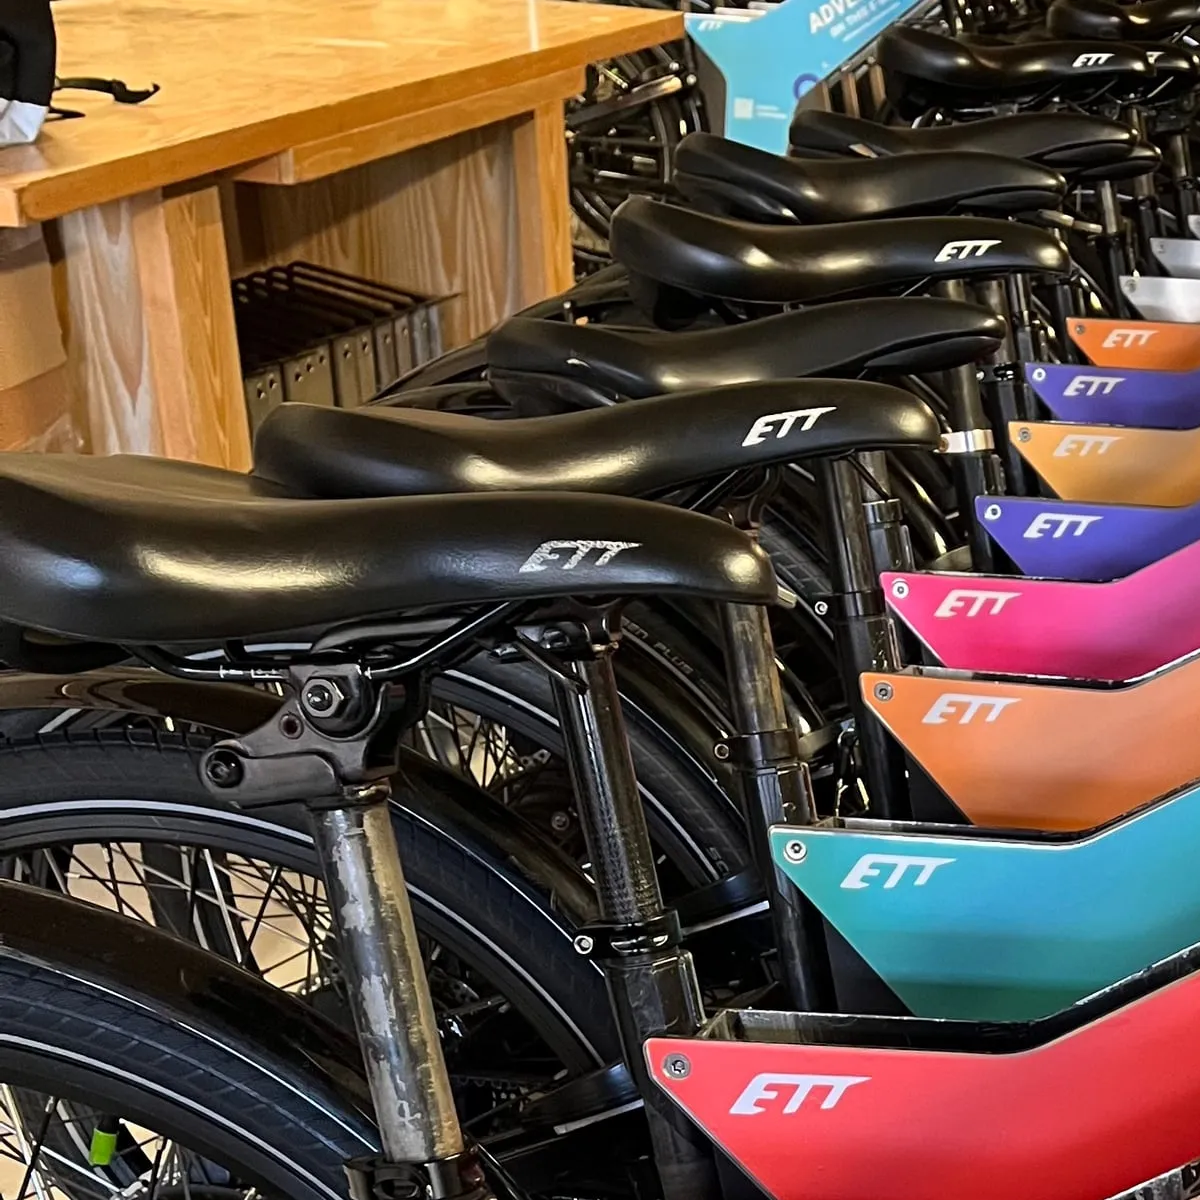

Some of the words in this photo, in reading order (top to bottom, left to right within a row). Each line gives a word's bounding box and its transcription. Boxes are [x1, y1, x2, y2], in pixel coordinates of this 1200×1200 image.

[1071, 53, 1115, 68] ETT
[934, 240, 1002, 263] ETT
[1102, 329, 1158, 347] ETT
[1063, 375, 1125, 396] ETT
[742, 406, 837, 447] ETT
[1052, 434, 1122, 457] ETT
[1022, 512, 1104, 538] ETT
[518, 539, 643, 573] ETT
[934, 589, 1022, 617] ETT
[921, 693, 1022, 725] ETT
[840, 854, 955, 889] ETT
[729, 1072, 870, 1116] ETT
